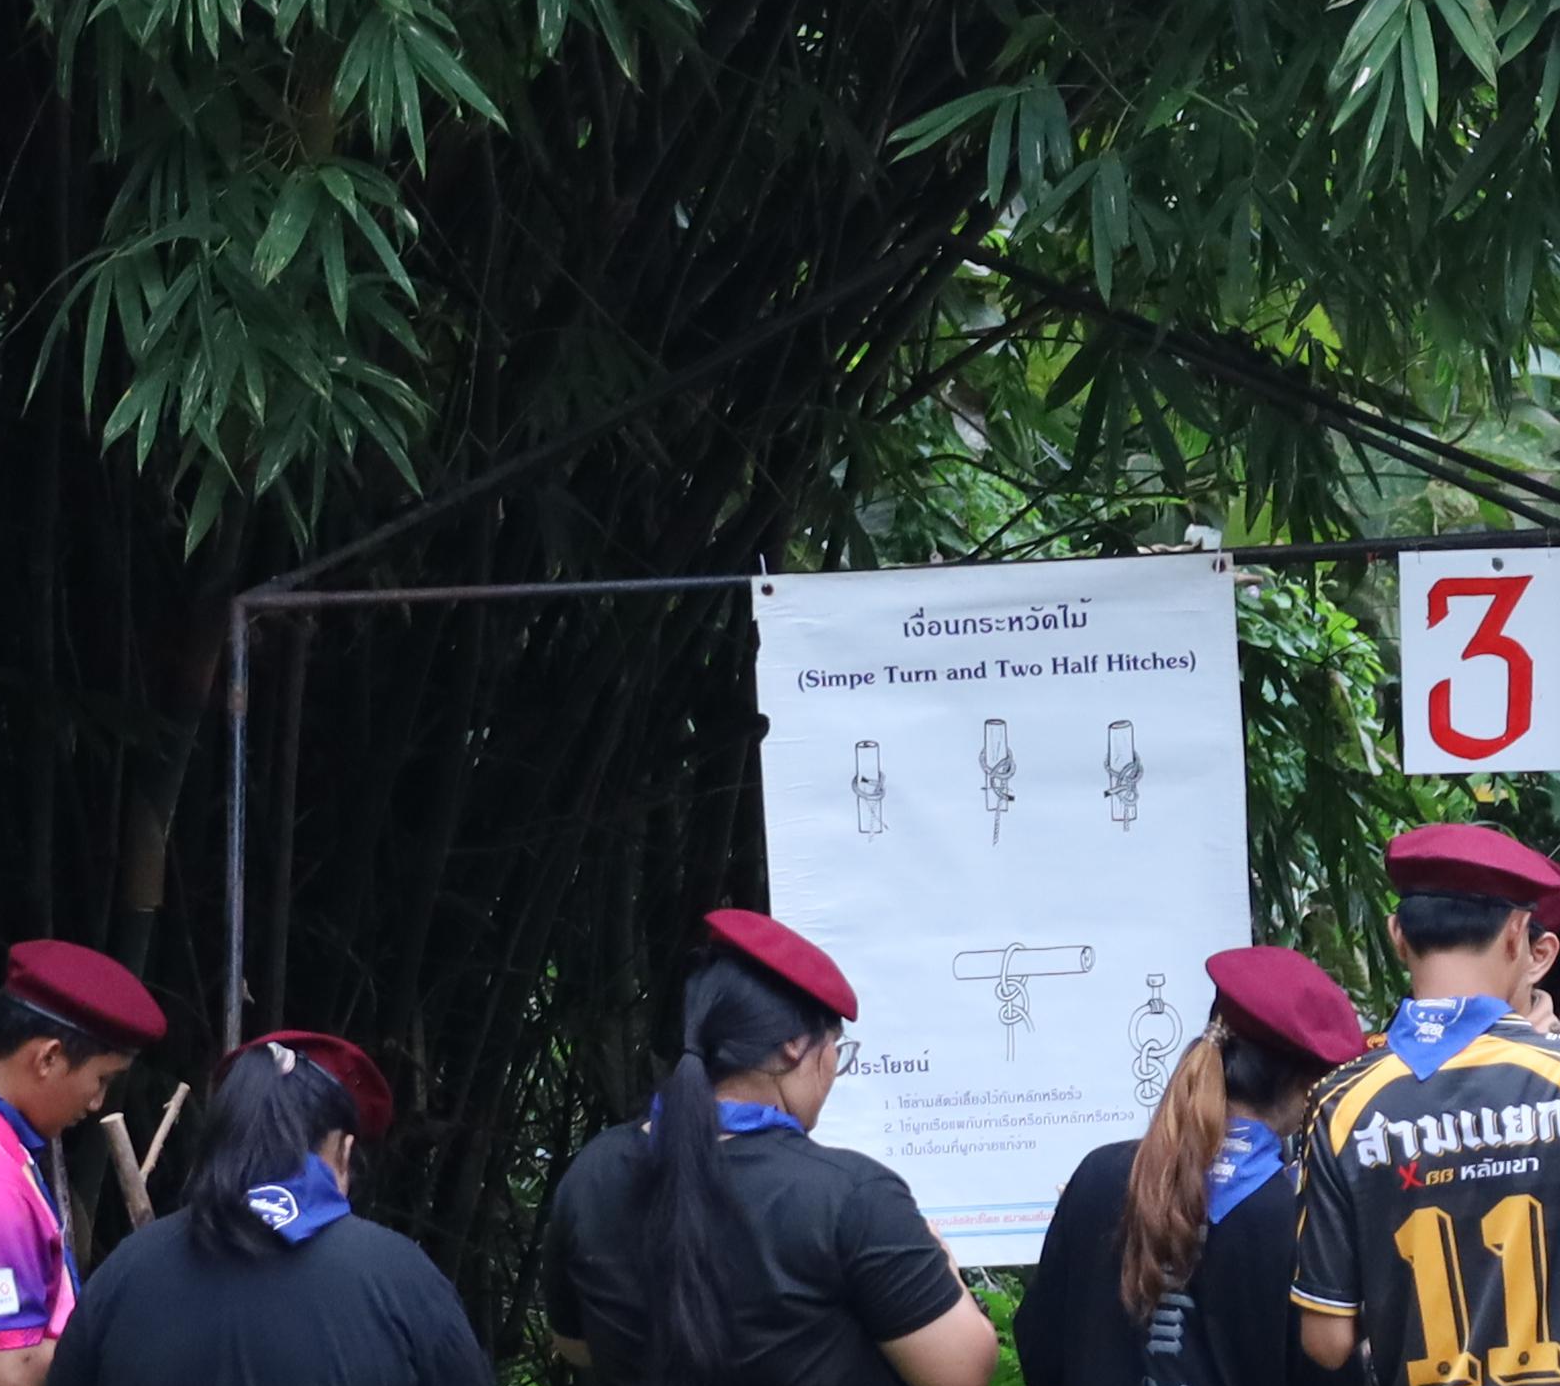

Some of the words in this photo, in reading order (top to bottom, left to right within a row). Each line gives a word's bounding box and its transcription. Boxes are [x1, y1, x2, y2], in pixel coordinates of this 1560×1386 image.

[902, 598, 1092, 638] เงื่อนกระหวัดไม้
[797, 669, 876, 692] (Simpe
[883, 666, 937, 684] Turn
[946, 661, 988, 681] and
[995, 660, 1043, 678] Two
[1051, 654, 1100, 675] Half
[1106, 649, 1197, 674] Hitches)
[1426, 574, 1533, 761] 3
[1397, 1160, 1425, 1190] X
[1460, 1157, 1539, 1181] หลังเขา
